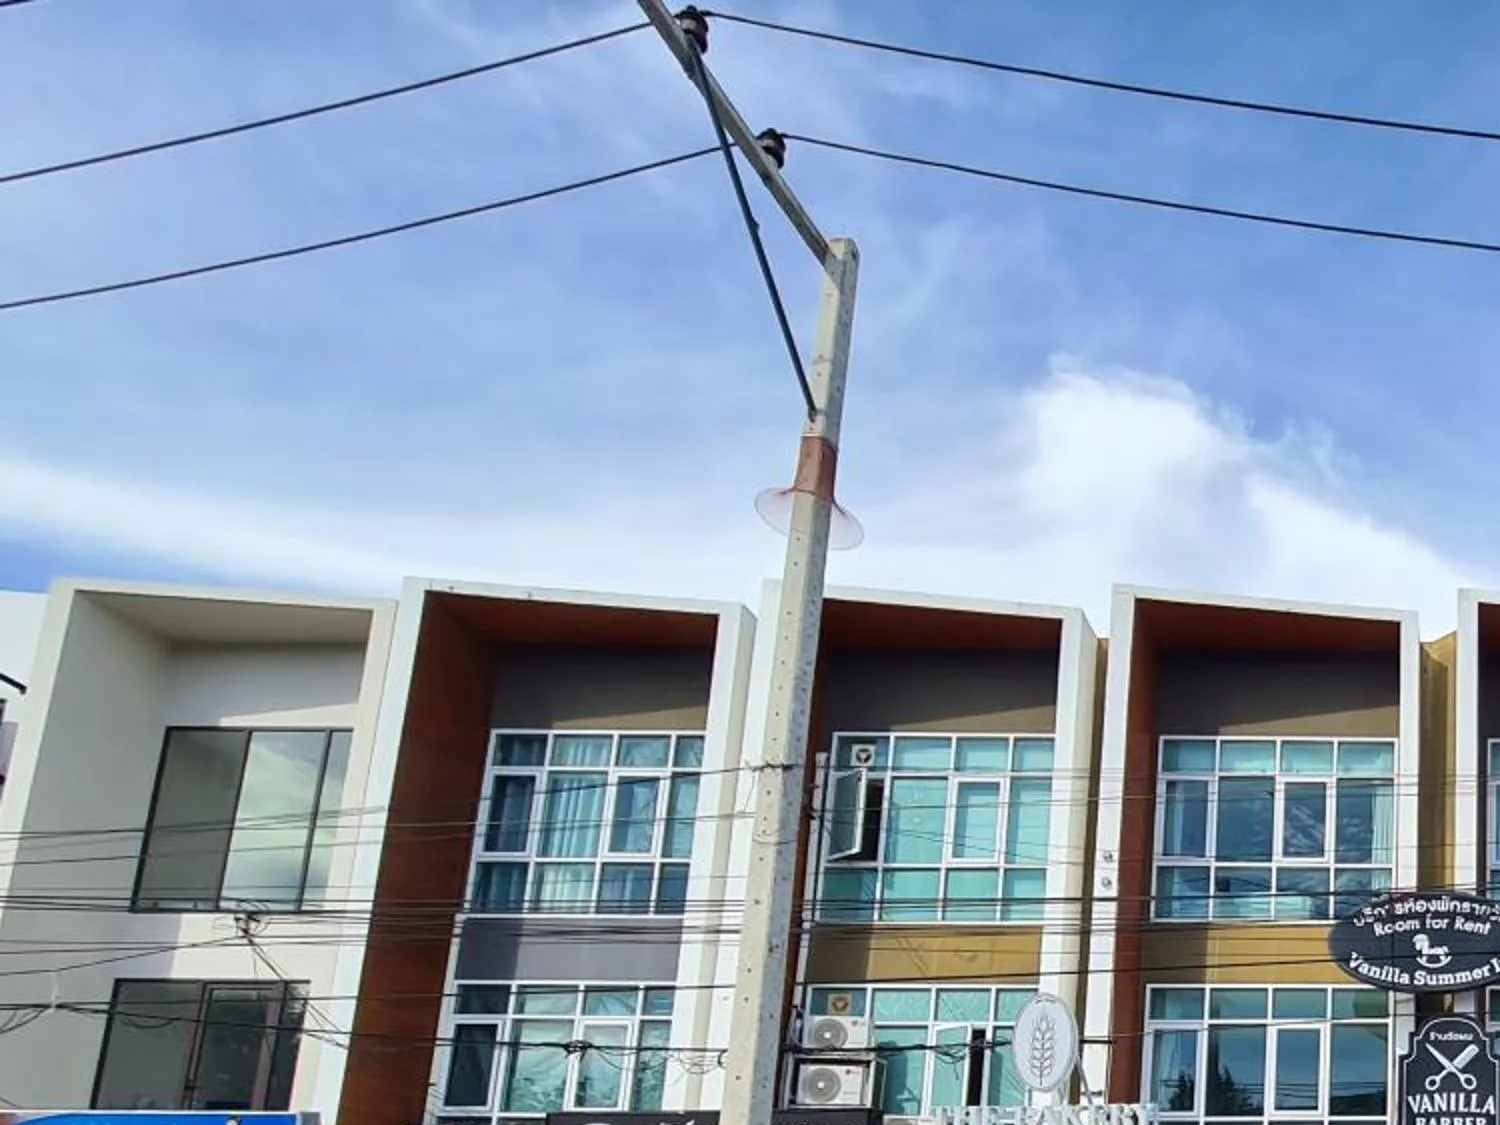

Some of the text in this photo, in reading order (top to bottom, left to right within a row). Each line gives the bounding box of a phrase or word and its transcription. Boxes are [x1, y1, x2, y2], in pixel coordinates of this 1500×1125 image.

[1374, 913, 1492, 936] Room for Rent
[1349, 951, 1410, 984] Vanilla
[1413, 966, 1490, 985] Summer
[1407, 1091, 1496, 1115] VANILLA
